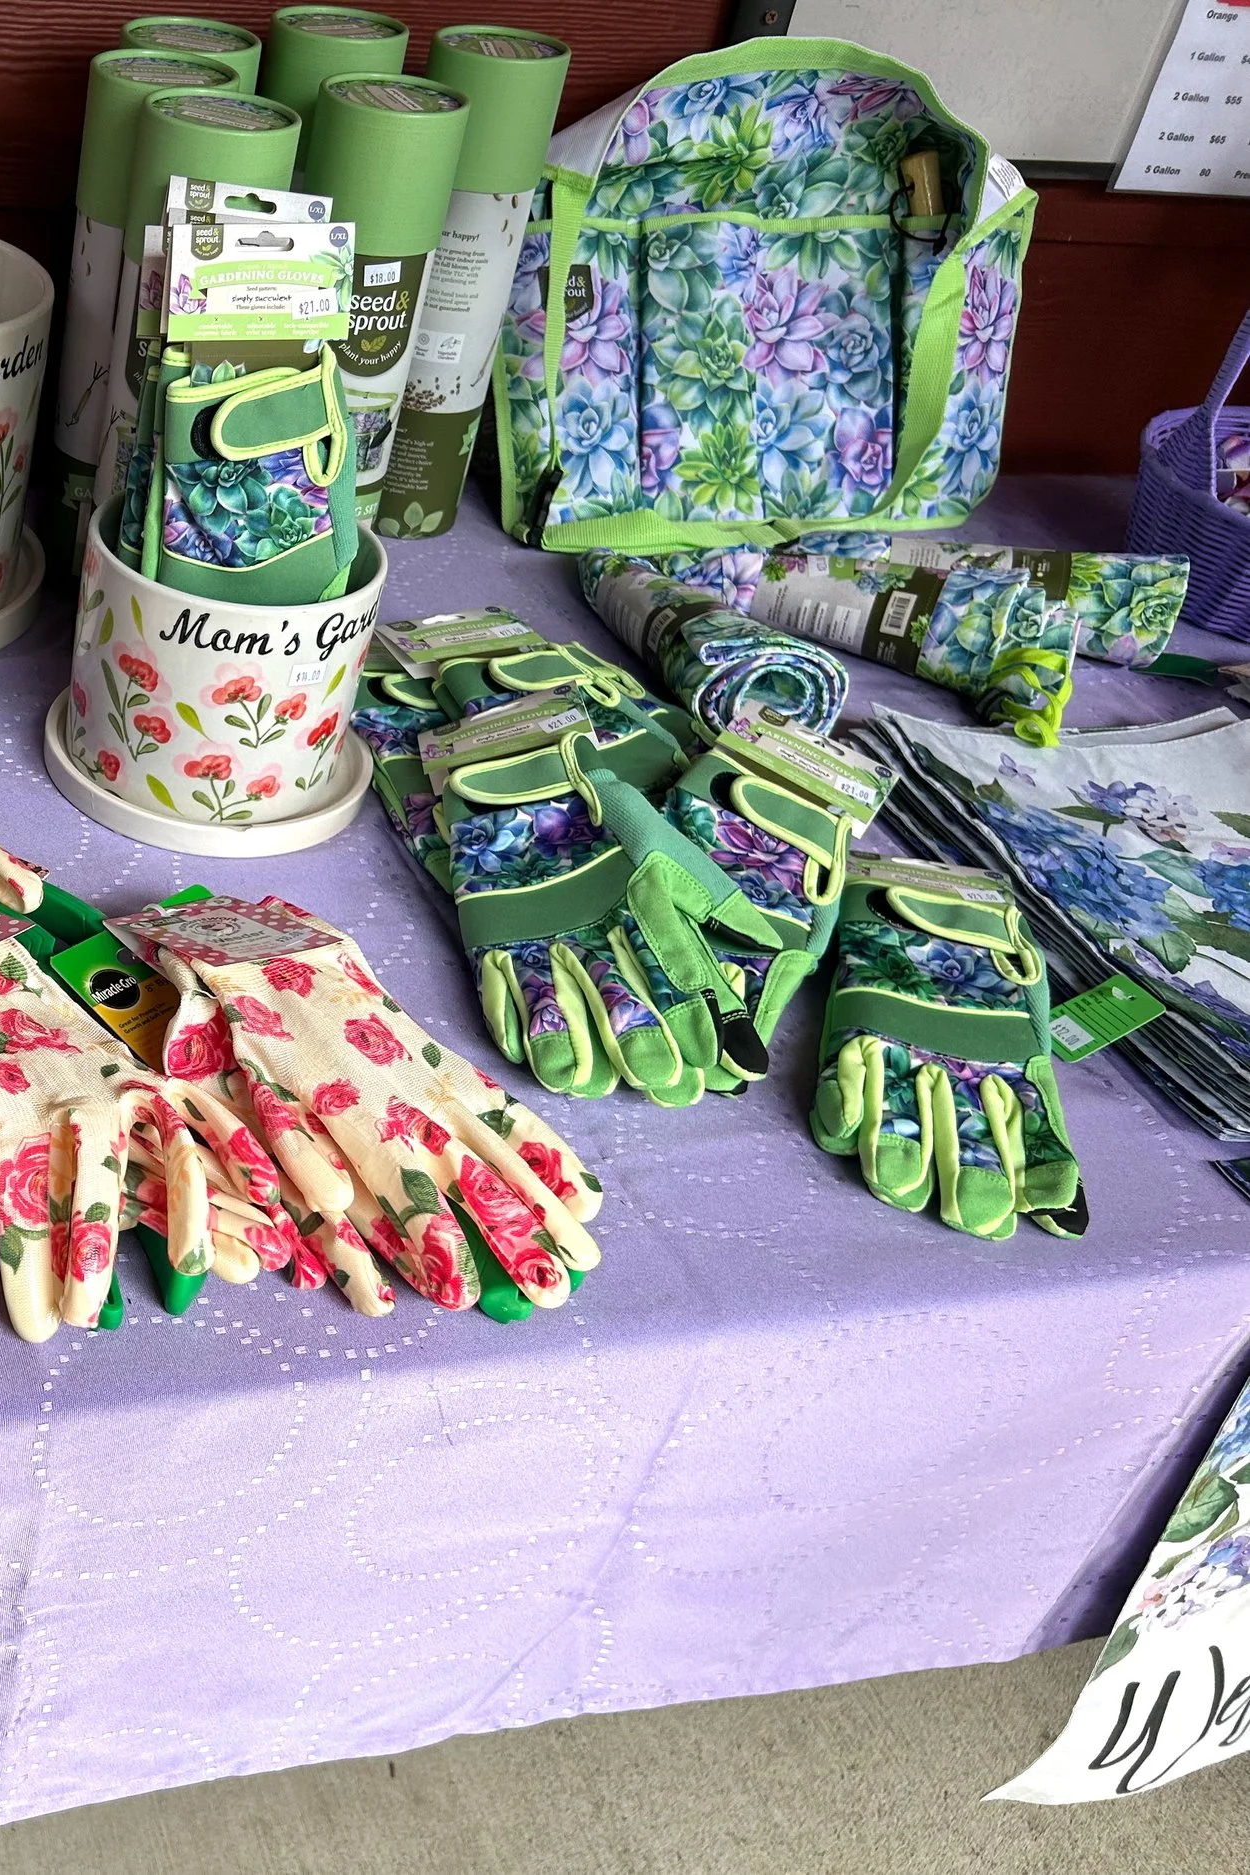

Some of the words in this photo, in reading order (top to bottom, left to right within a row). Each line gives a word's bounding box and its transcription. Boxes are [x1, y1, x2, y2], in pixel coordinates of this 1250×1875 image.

[1207, 9, 1238, 22] Orange
[1197, 52, 1225, 62] Gallon
[1173, 92, 1180, 101] 2
[1182, 92, 1209, 103] Gallon
[1225, 95, 1242, 105] $55
[1158, 131, 1165, 140] 2
[1167, 132, 1194, 143] Gallon
[1210, 135, 1226, 144] $65
[1145, 165, 1151, 174] 5
[1153, 165, 1180, 175] Gallon
[1200, 168, 1211, 177] 80
[1234, 170, 1250, 180] Pre
[190, 190, 210, 199] sprout
[195, 236, 220, 246] sprout
[452, 230, 480, 242] happy!
[199, 270, 274, 285] GARDENING
[278, 271, 325, 283] GLOVES
[370, 271, 396, 284] $18.00
[232, 294, 253, 303] simply
[567, 288, 586, 297] out
[299, 299, 330, 315] $21.00
[349, 311, 407, 336] sprout
[338, 342, 359, 362] plant
[358, 357, 379, 366] your
[380, 341, 402, 362] happy
[159, 608, 300, 656] Mom's
[316, 594, 379, 661] Gard
[444, 720, 512, 745] GARDENING
[512, 709, 557, 724] GLOVES
[548, 714, 577, 730] $21.00
[758, 727, 822, 760] GARDENING
[841, 783, 869, 800] $21.00
